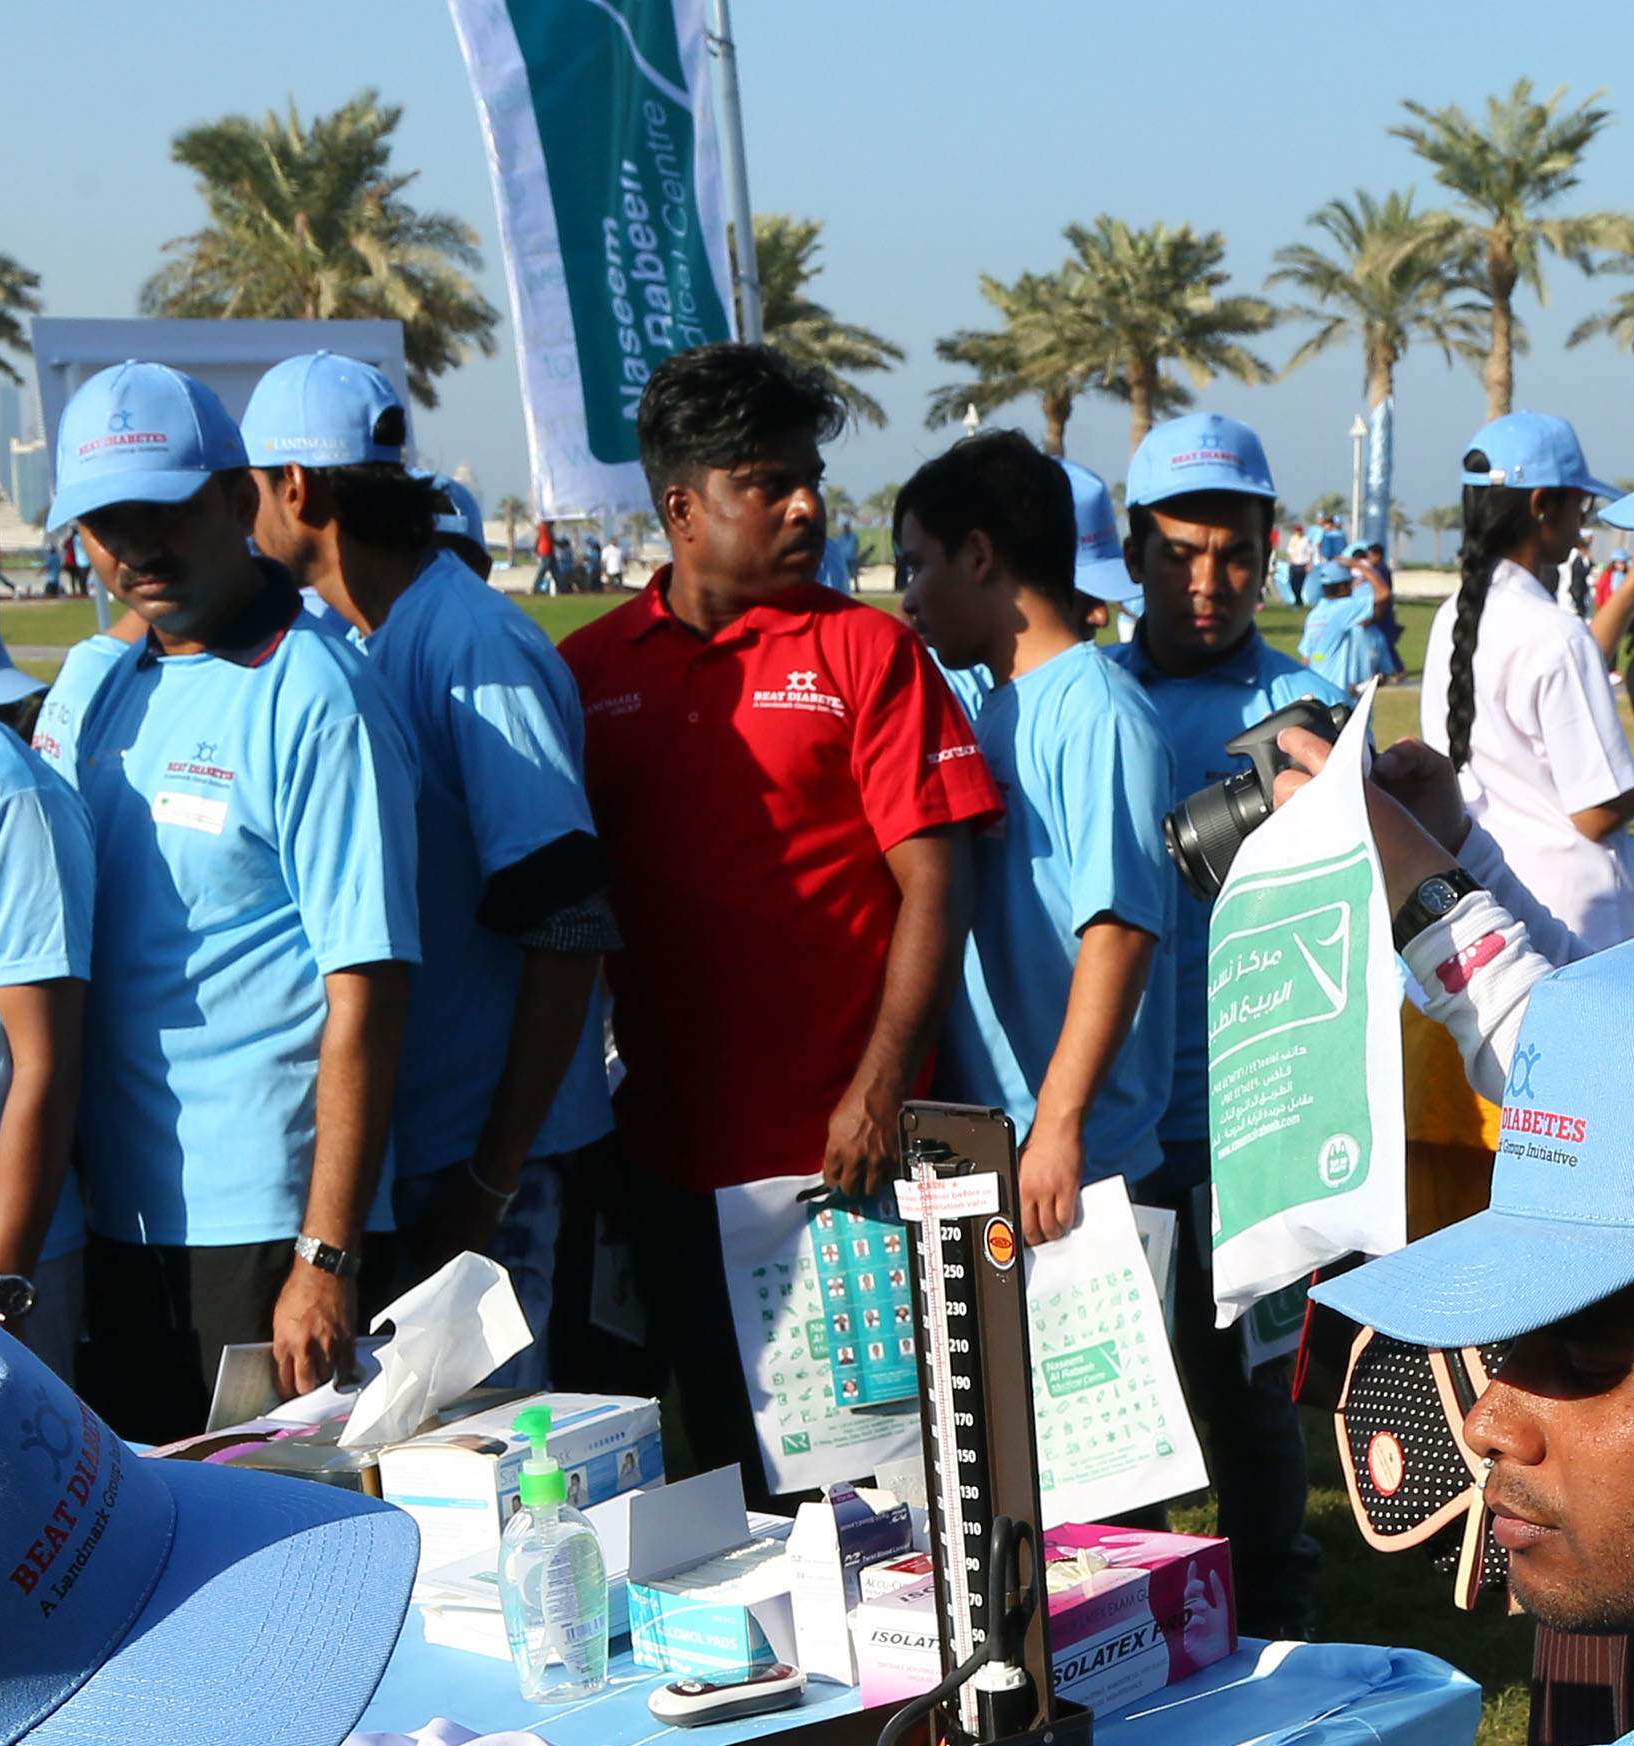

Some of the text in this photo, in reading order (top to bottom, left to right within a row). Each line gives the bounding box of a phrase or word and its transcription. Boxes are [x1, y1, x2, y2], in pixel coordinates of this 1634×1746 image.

[642, 101, 689, 246] Centre
[602, 217, 650, 423] Naseem
[752, 691, 787, 703] BEAT
[1208, 949, 1283, 1001] مركز نسي
[1239, 979, 1294, 1023] الربيع
[1526, 1139, 1579, 1168] Initiative
[941, 1227, 962, 1242] 270
[943, 1264, 965, 1279] 250
[946, 1302, 967, 1317] 230
[949, 1339, 970, 1353] 210
[952, 1376, 972, 1390] 190
[954, 1413, 974, 1427] 170
[957, 1450, 976, 1463] 150
[960, 1486, 979, 1500] 130
[9, 1499, 80, 1596] BEAT
[38, 1599, 57, 1619] A
[50, 1508, 112, 1601] Landmark
[965, 1558, 980, 1571] 90
[969, 1593, 983, 1607] 70
[706, 1632, 739, 1651] PADS
[870, 1629, 943, 1651] ISOLAT
[972, 1629, 986, 1643] 50
[1052, 1626, 1149, 1688] SOLATEX
